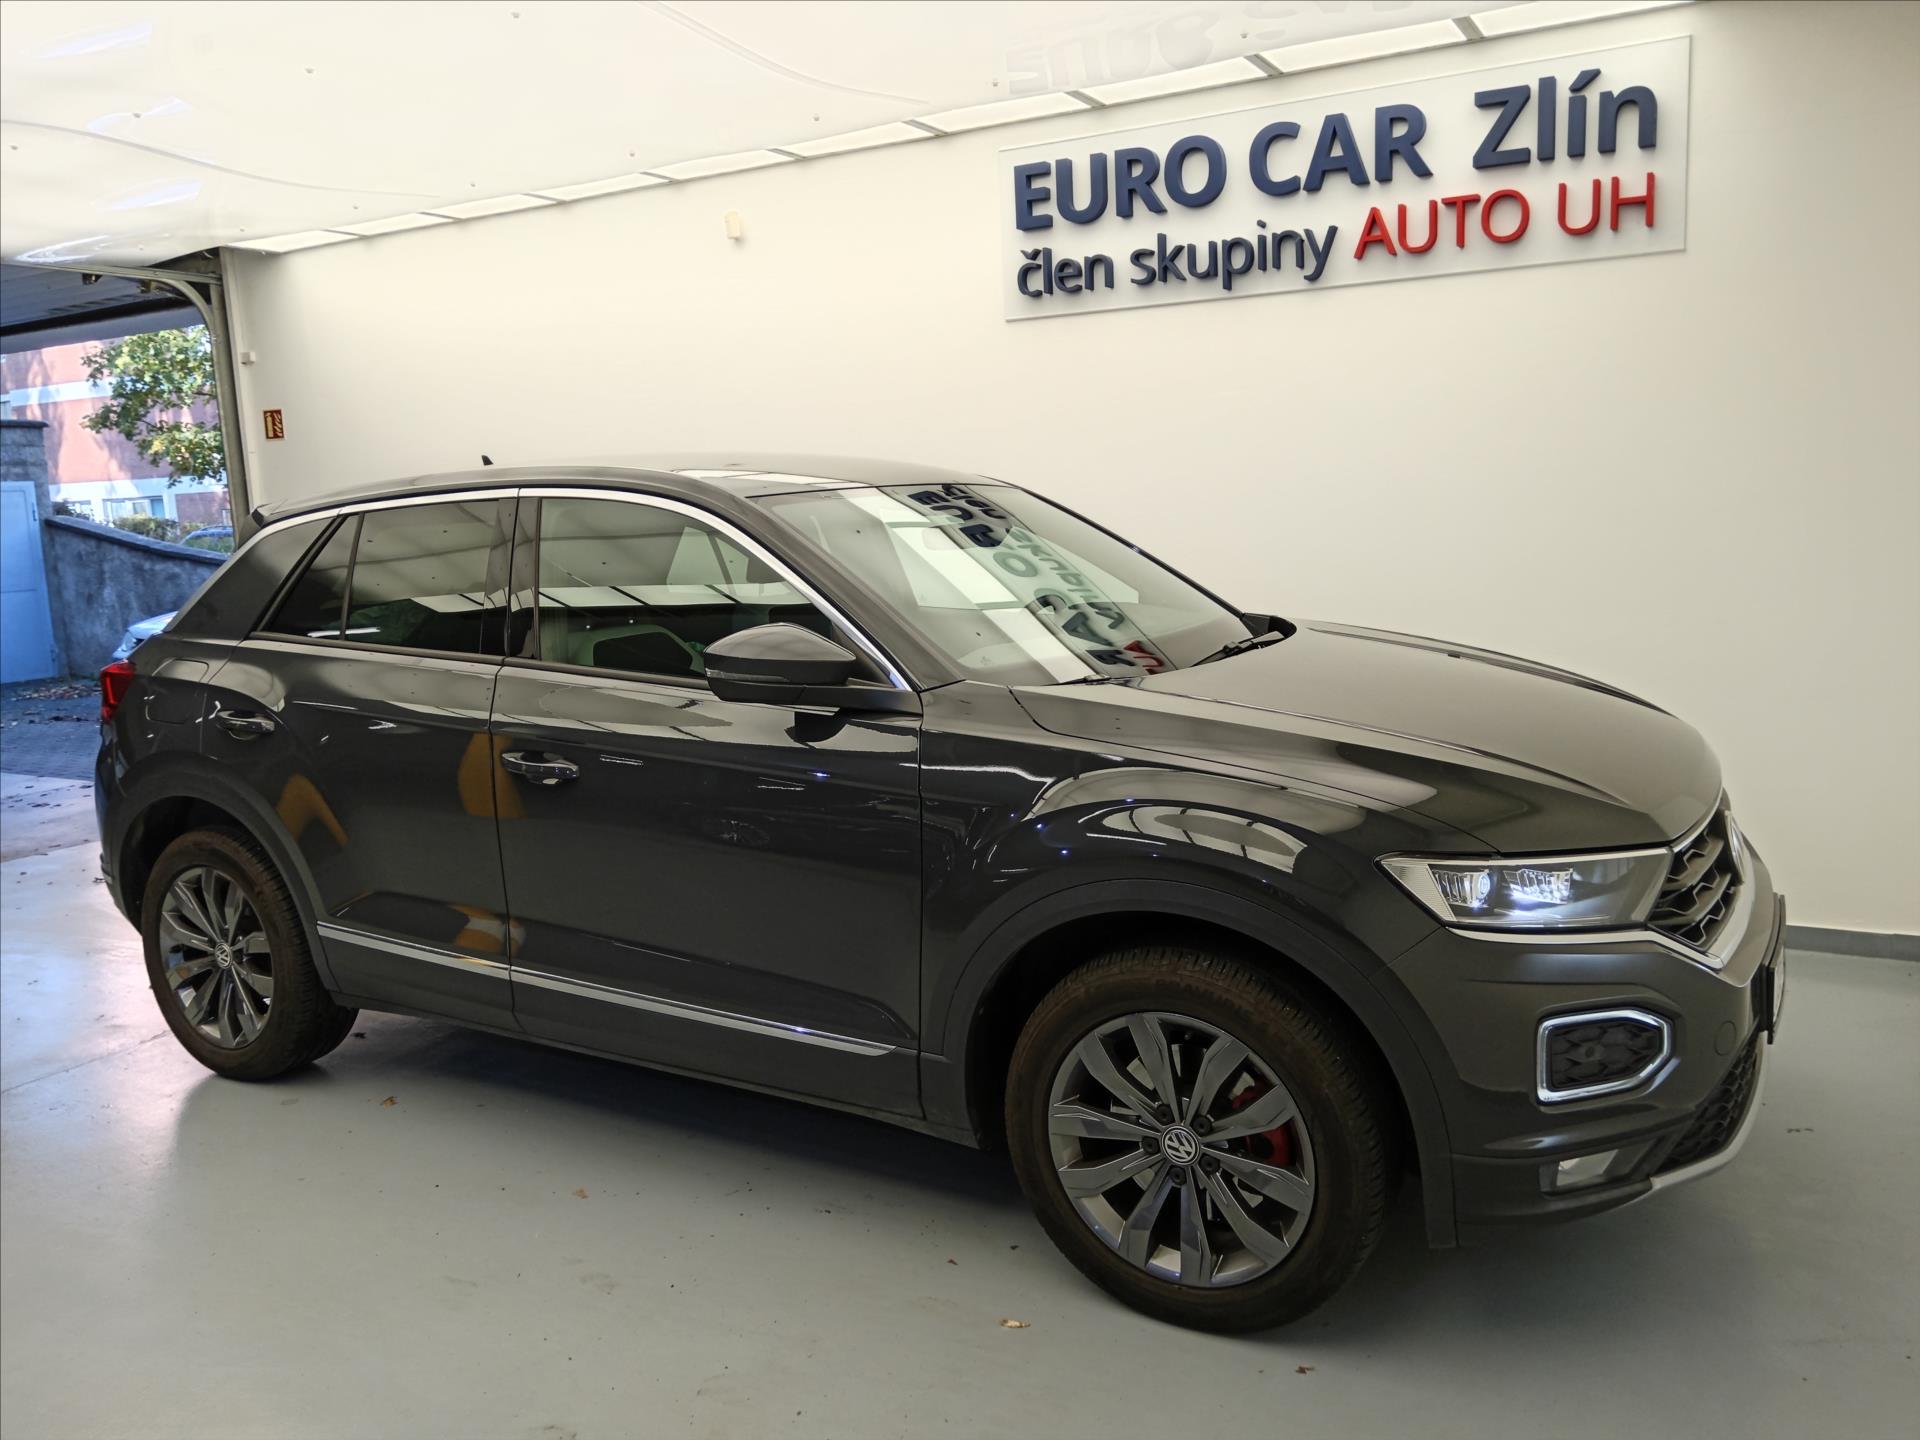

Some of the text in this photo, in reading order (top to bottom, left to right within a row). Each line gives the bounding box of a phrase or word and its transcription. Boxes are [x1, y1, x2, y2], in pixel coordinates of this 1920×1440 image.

[1014, 68, 1658, 233] EURO CAR Zlín
[1017, 172, 1655, 300] člen skupiny AUTO UH
[1163, 1127, 1199, 1165] VW
